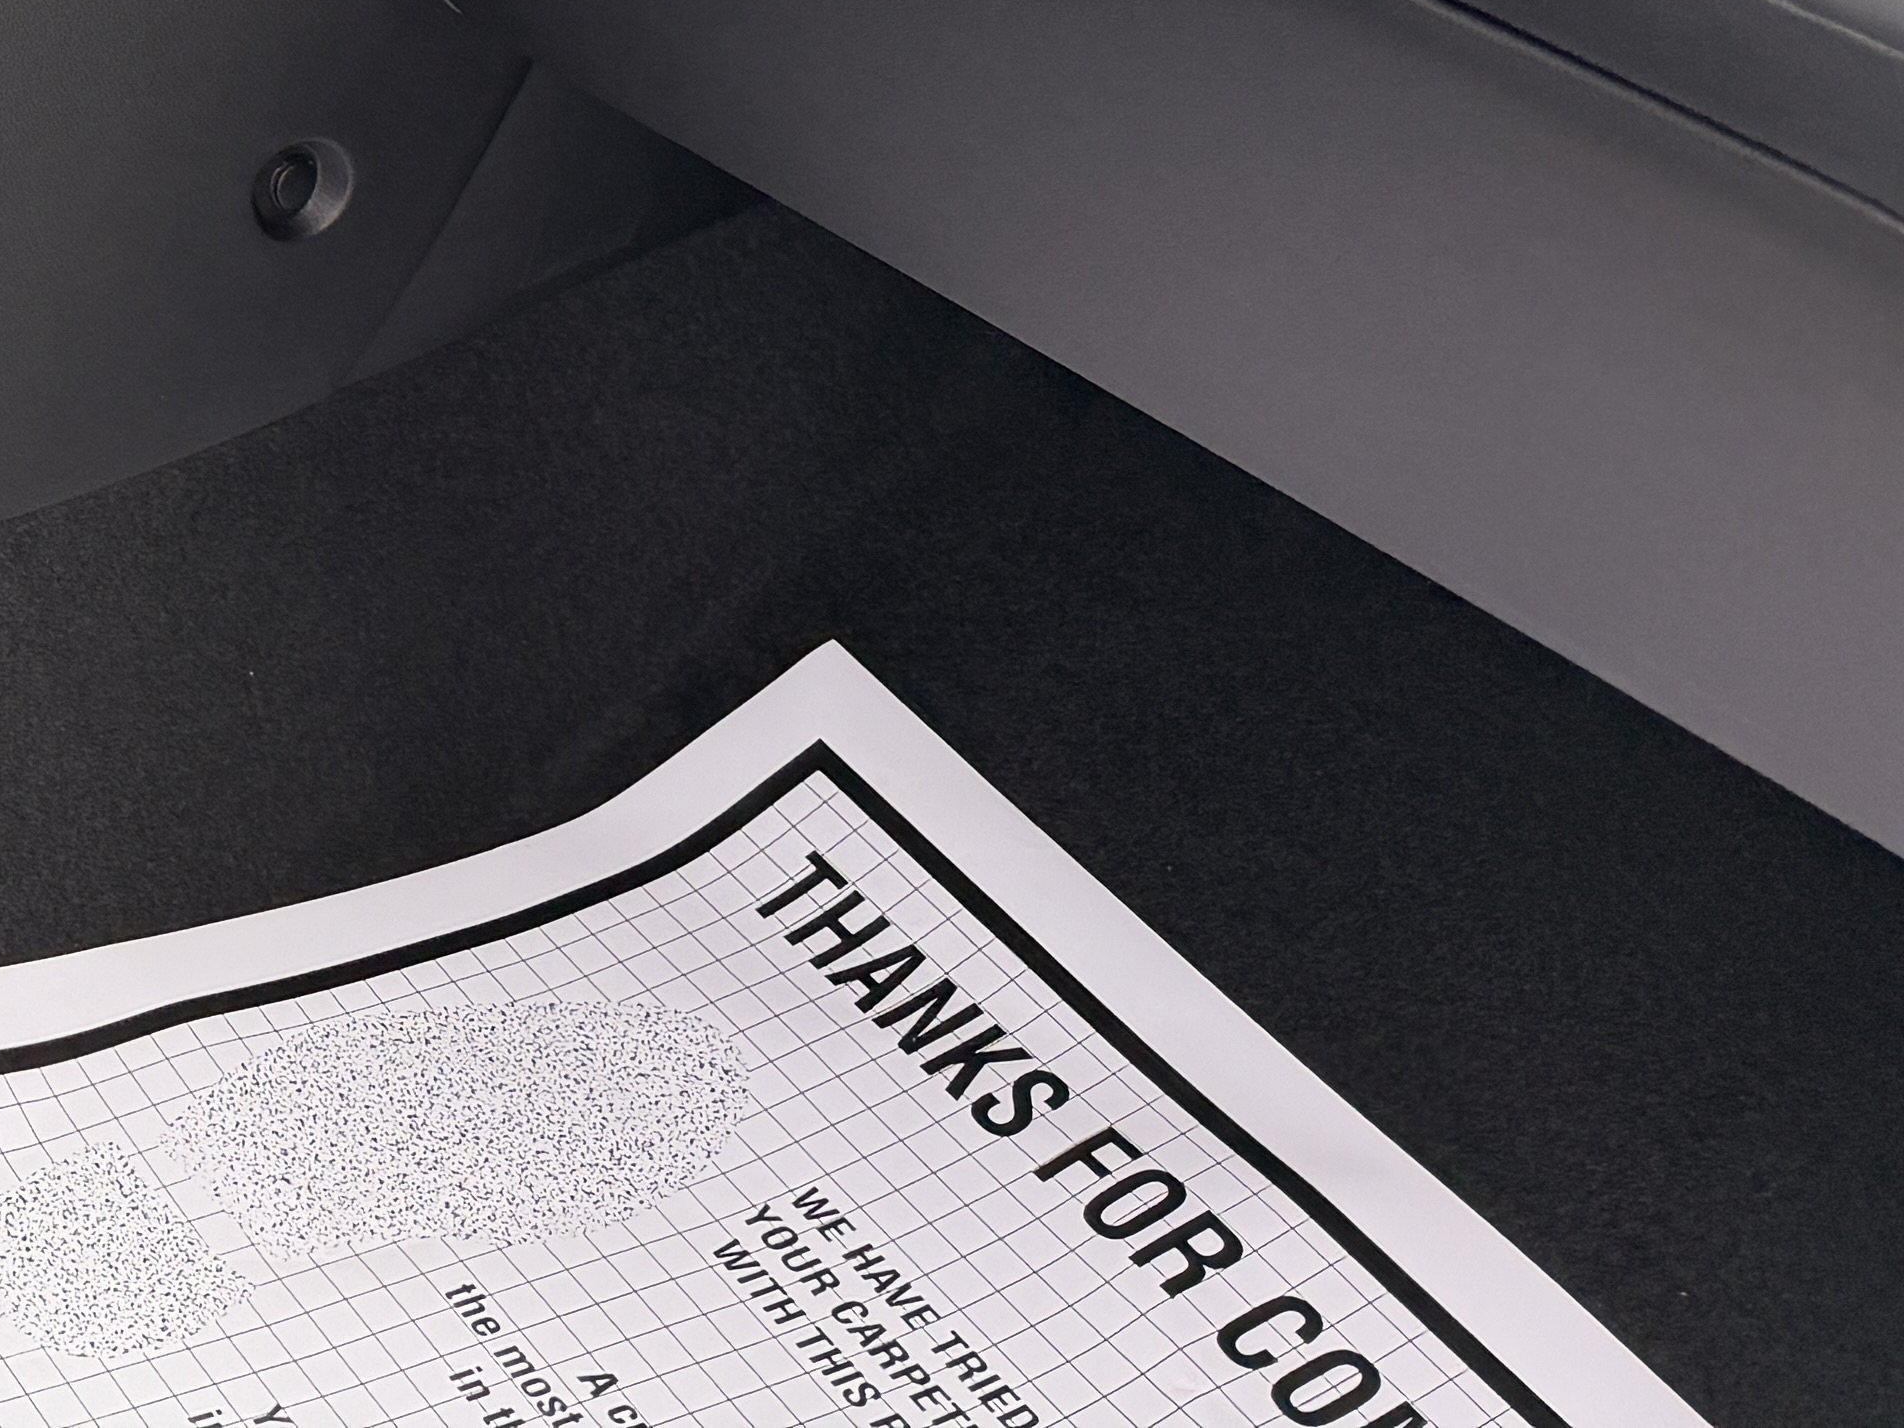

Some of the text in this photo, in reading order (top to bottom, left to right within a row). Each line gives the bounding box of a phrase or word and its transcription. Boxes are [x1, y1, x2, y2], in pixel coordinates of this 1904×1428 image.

[755, 850, 1072, 1138] THANKS
[1031, 1126, 1245, 1299] FOR
[444, 1281, 585, 1428] the most
[448, 1365, 491, 1403] in
[576, 1373, 620, 1399] A
[712, 1237, 883, 1408] WITH THIS
[744, 1203, 979, 1428] YOUR CARPET
[791, 1185, 858, 1243] WE
[841, 1242, 942, 1332] HAVE
[930, 1329, 1040, 1428] TRIED
